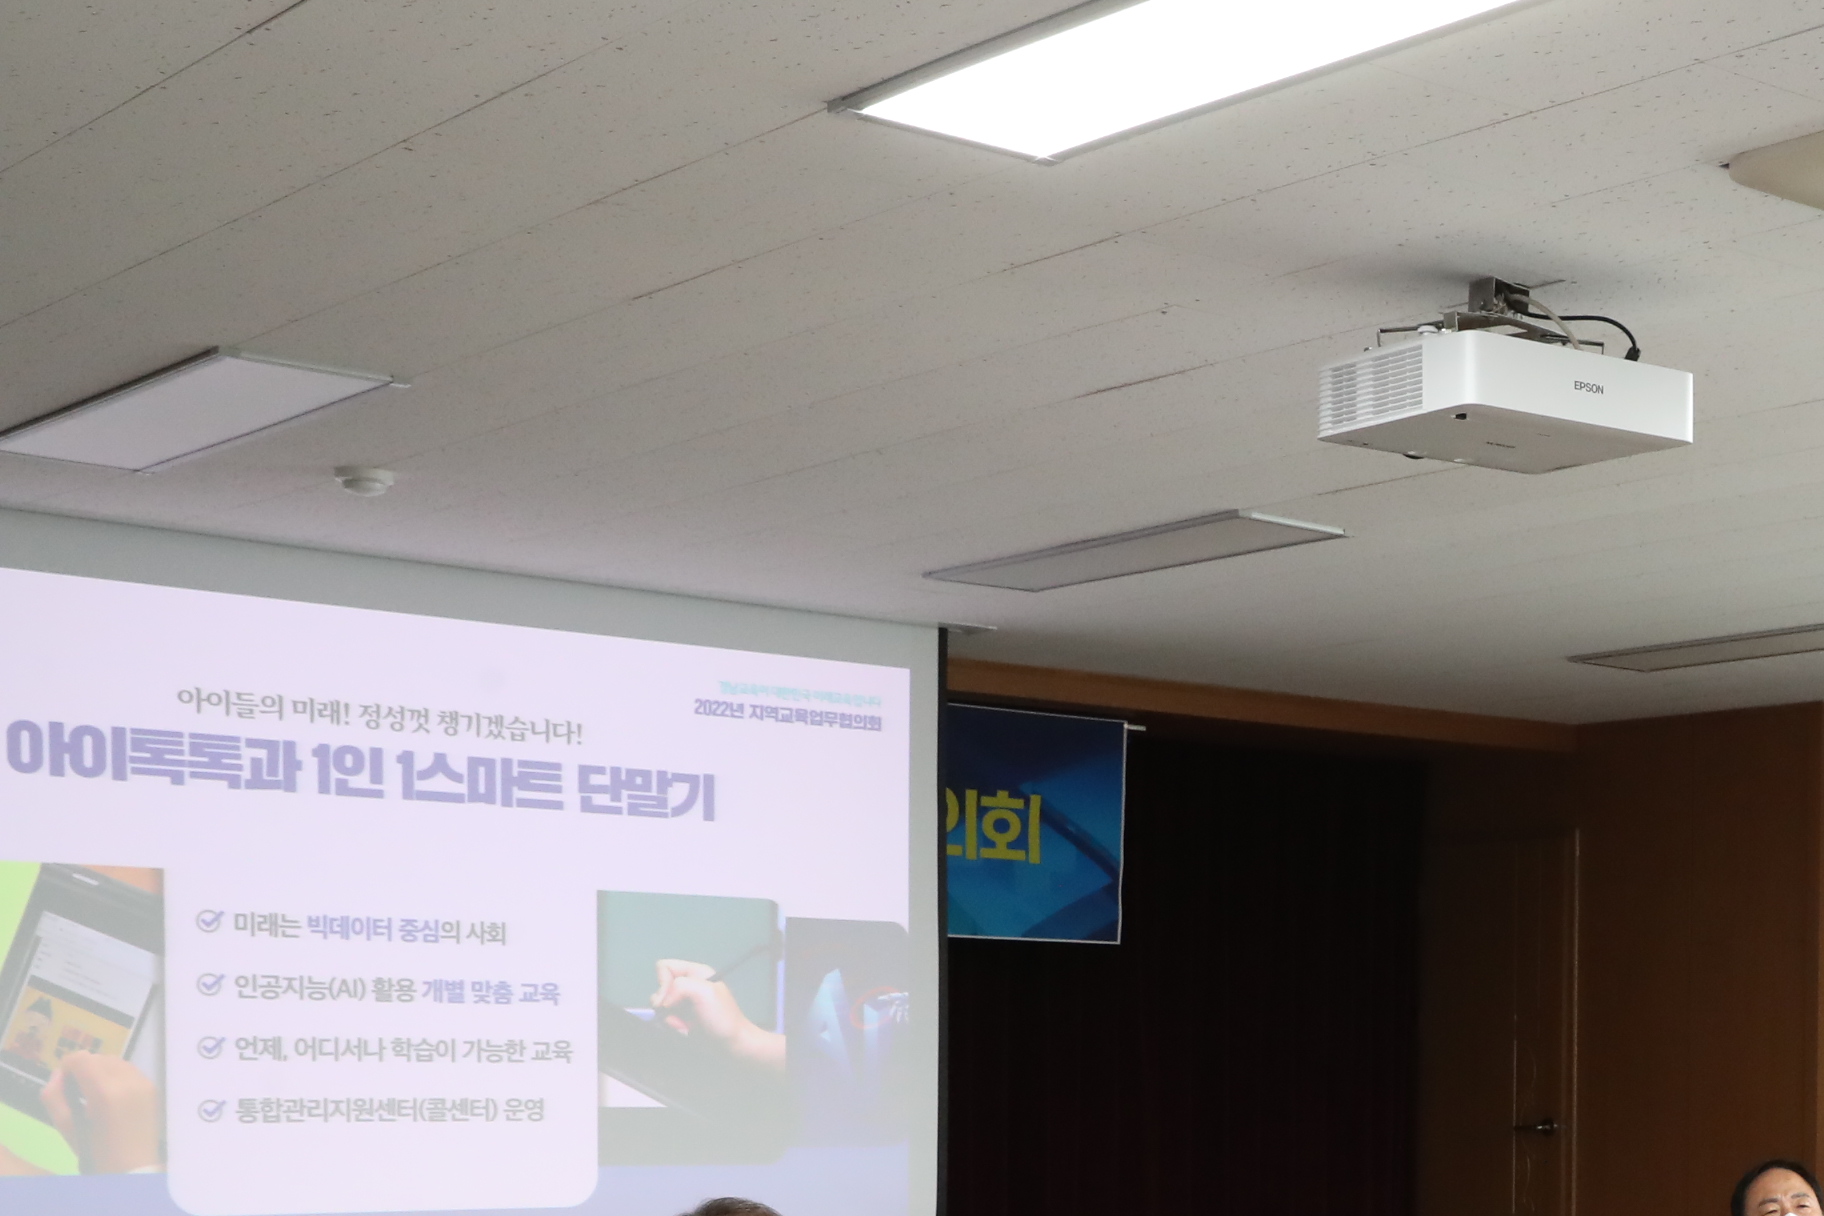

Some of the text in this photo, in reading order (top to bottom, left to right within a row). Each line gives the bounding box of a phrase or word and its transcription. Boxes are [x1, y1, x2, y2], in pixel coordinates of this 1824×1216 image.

[1574, 380, 1604, 394] EPSON
[176, 685, 584, 747] 아이들의 미래! 정성껏 챙기겠습니다!
[694, 697, 882, 732] 2022년 지역교육업무협의회
[5, 718, 717, 823] 아이톡톡과 1인 1스마트 단말기
[234, 910, 507, 946] 미래는 빅데이터 중심의 사회
[234, 972, 561, 1006] 인공지능(AI) 활용 개별 맞춤 교육
[235, 1035, 574, 1064] 언제, 어디서나 학습이 가능한 교육
[235, 1097, 546, 1124] 통합관리지원센터(콜센터) 운영
